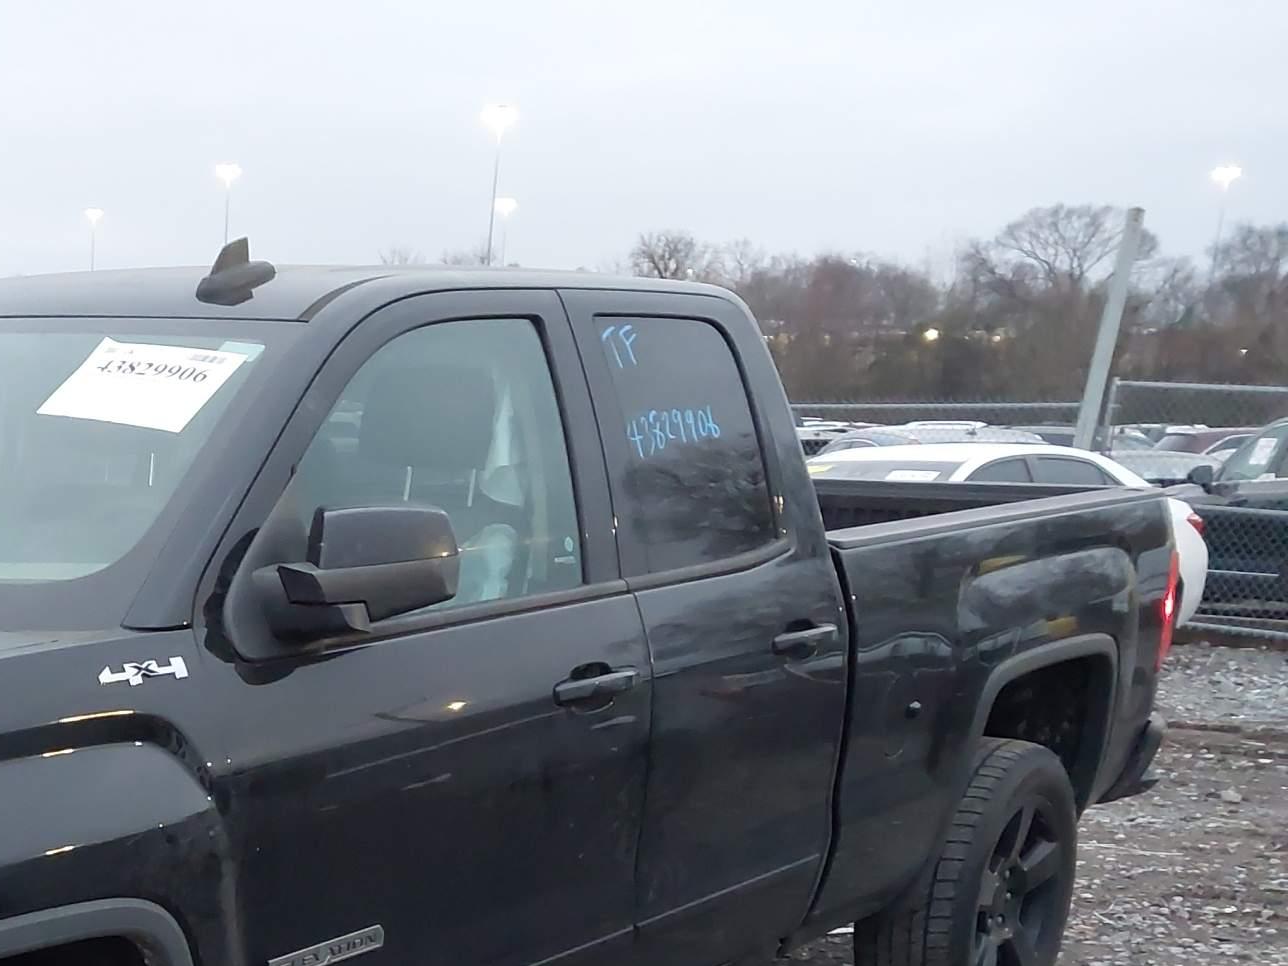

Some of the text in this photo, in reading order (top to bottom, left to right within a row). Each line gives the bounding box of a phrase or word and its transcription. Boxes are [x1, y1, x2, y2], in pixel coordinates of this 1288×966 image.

[601, 324, 637, 368] TF
[96, 359, 209, 383] 43829906
[627, 405, 721, 459] 43829906
